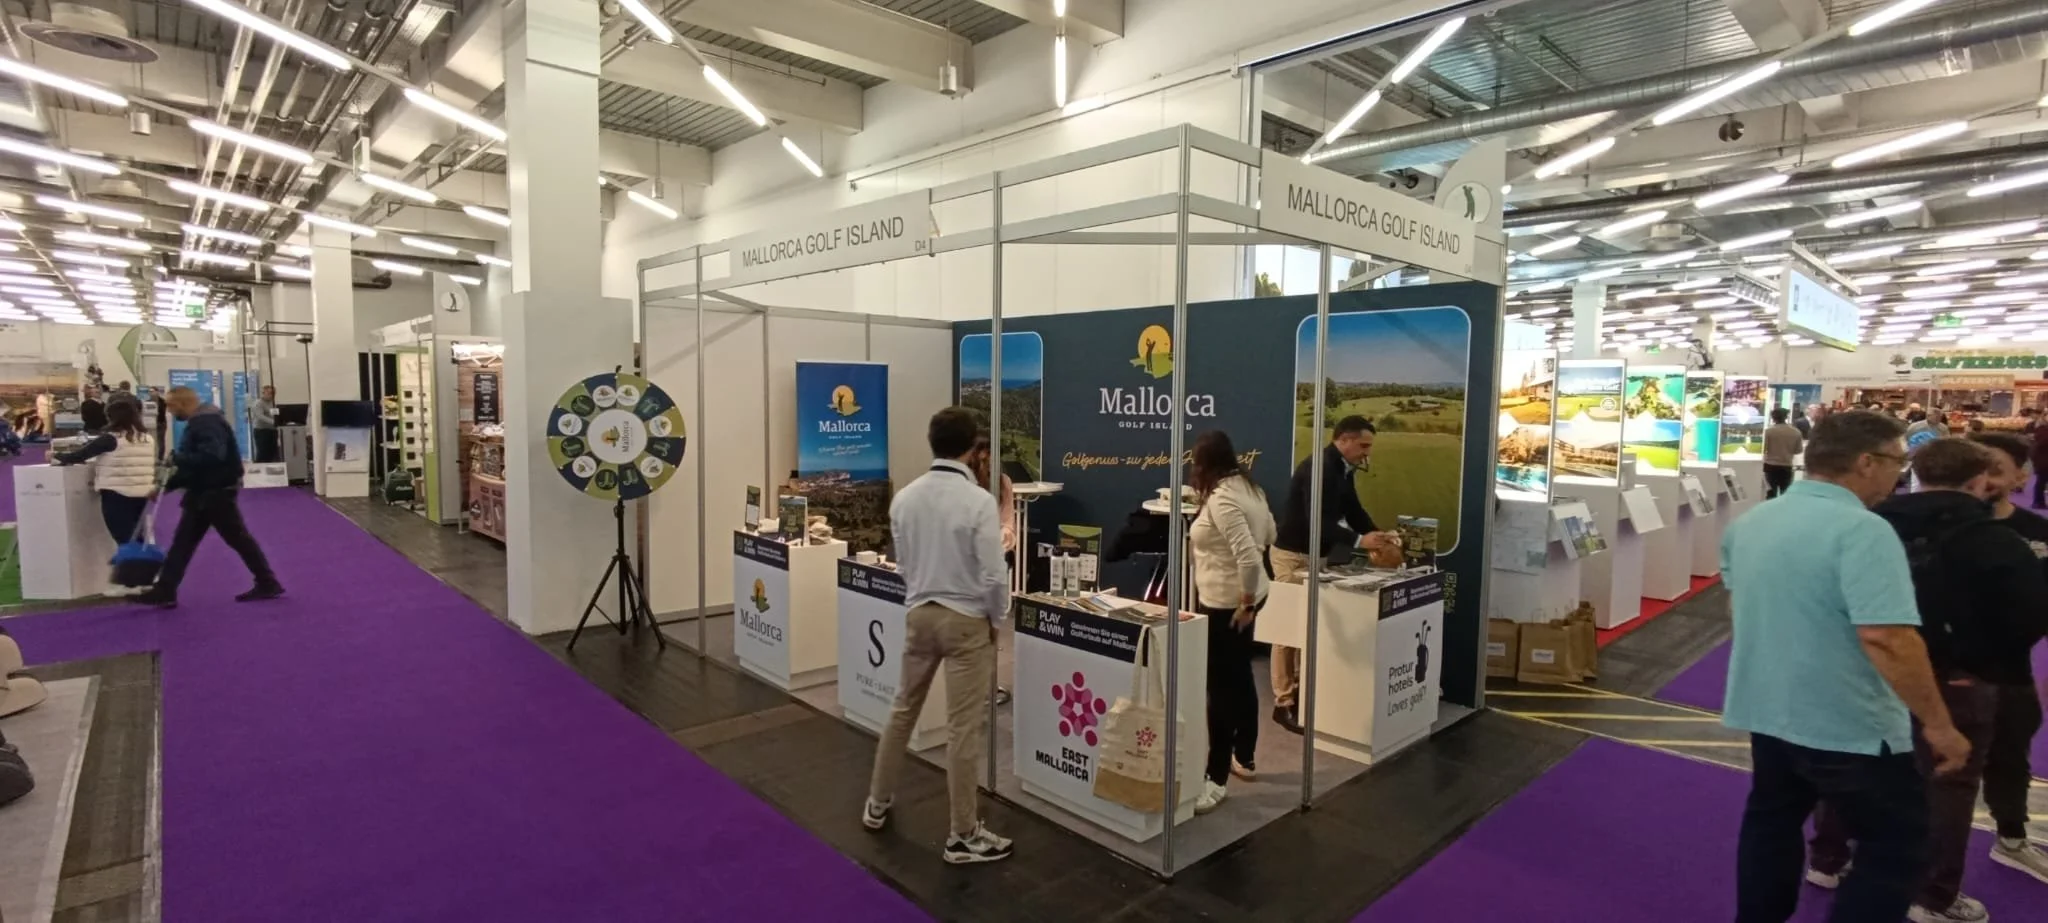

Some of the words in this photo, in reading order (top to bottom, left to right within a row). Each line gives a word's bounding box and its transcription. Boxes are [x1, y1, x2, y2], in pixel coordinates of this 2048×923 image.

[1288, 183, 1378, 232] MALLORCA
[1381, 211, 1417, 241] GOLF
[1420, 224, 1460, 254] ISLAND
[743, 238, 804, 267] MALLORCA
[805, 229, 842, 254] GOLF
[846, 216, 904, 247] ISLAND
[915, 240, 926, 252] D4
[1099, 386, 1216, 417] Malloca
[818, 420, 871, 432] Mallorca
[1118, 421, 1146, 429] GOLF
[1150, 422, 1193, 431] ISLD
[740, 608, 782, 641] Mallorca
[1039, 610, 1061, 623] PLAY
[868, 619, 885, 668] S
[1101, 637, 1112, 646] auf
[1389, 661, 1414, 680] Protur
[1389, 675, 1413, 696] hotels
[1036, 750, 1089, 782] MALLORCA
[1062, 747, 1089, 767] EAST
